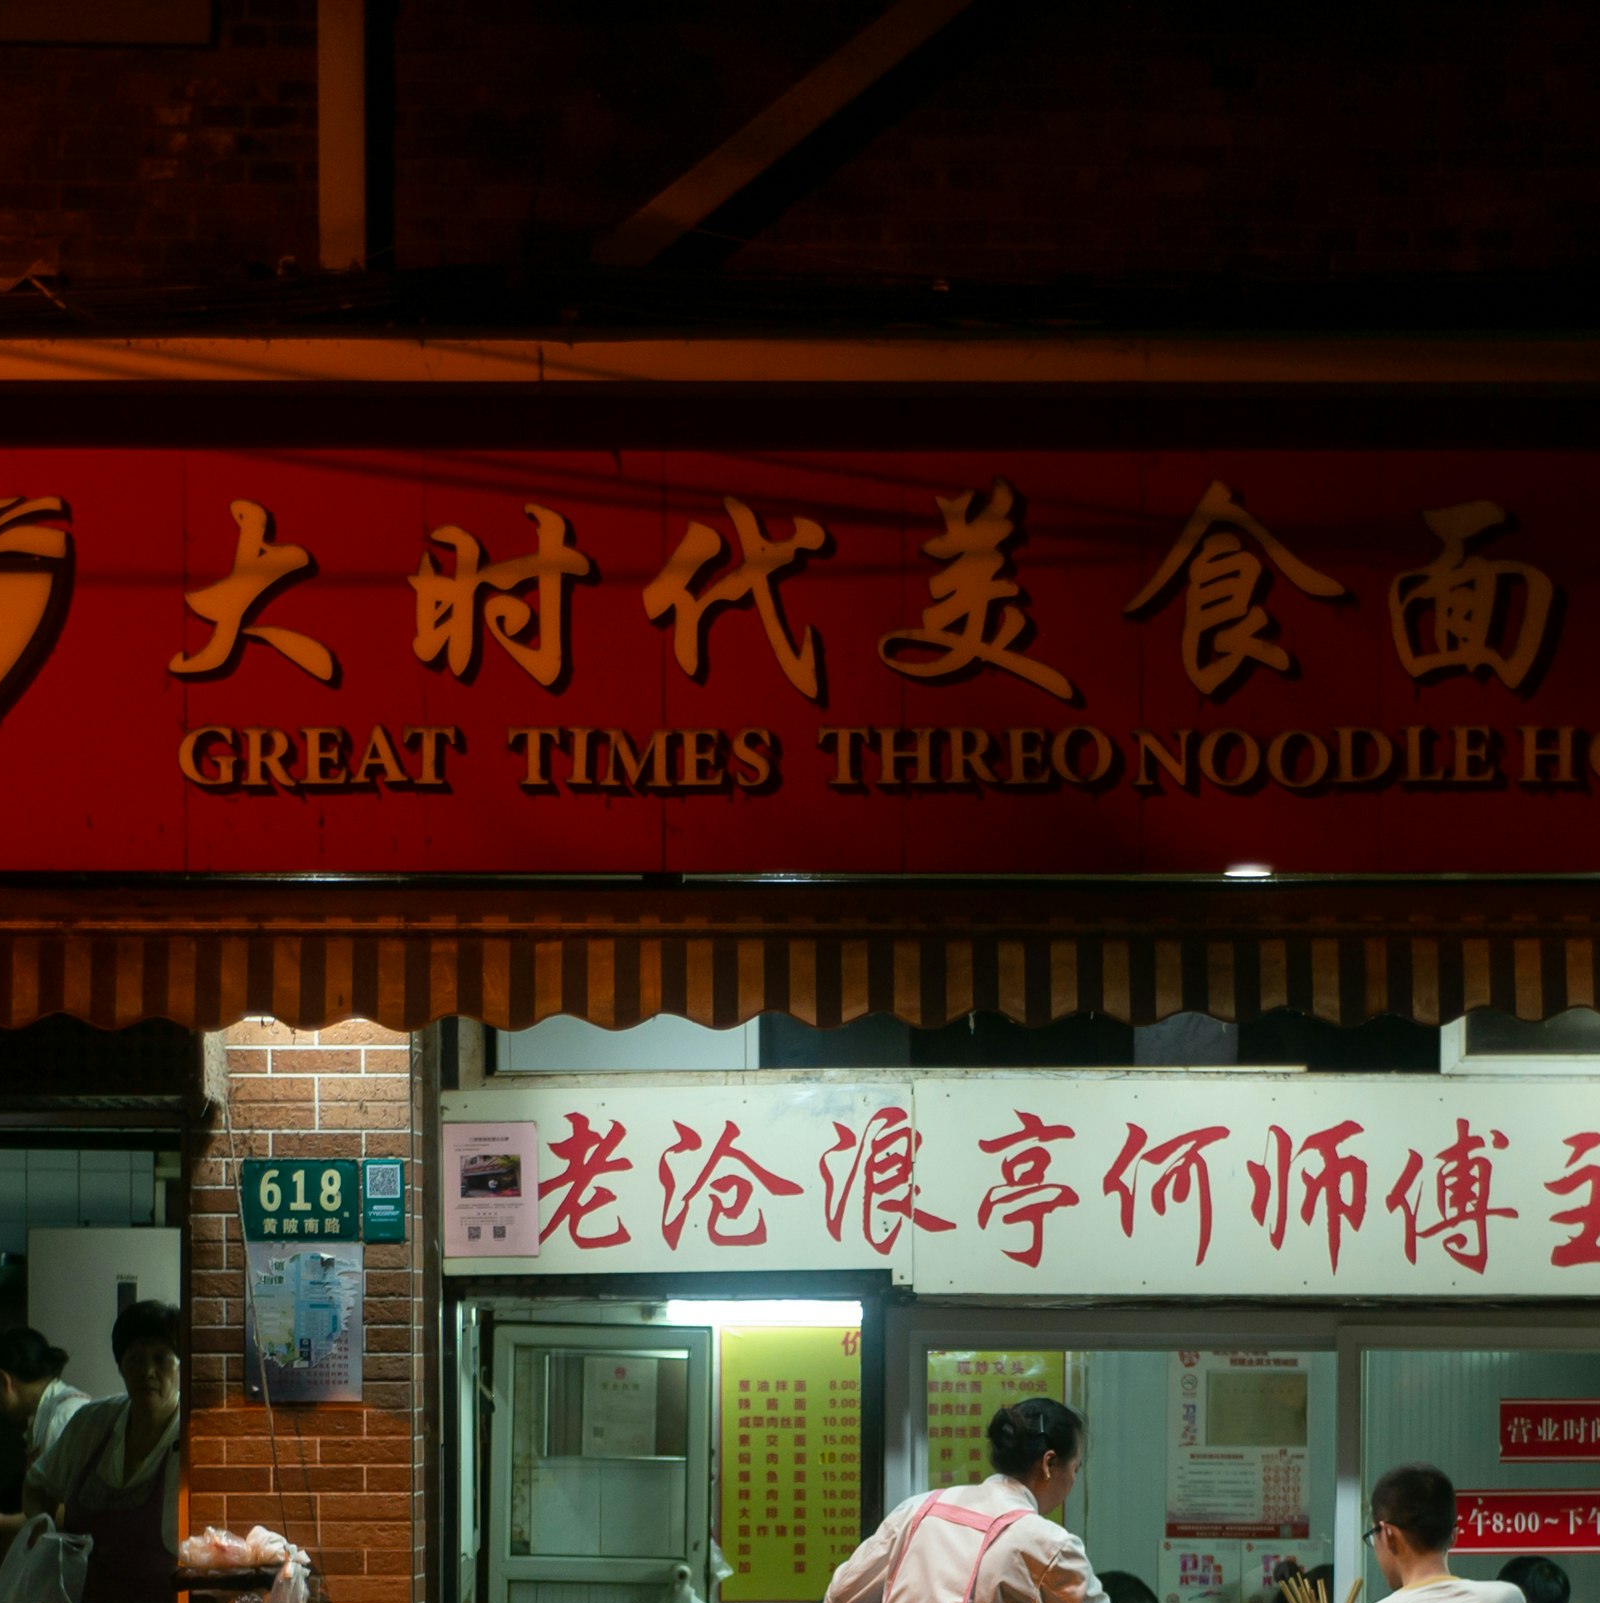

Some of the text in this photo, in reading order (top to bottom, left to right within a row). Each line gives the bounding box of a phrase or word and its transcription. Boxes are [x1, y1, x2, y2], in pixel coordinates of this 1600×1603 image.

[177, 724, 456, 788] GREAT
[508, 725, 774, 790] TIMES
[818, 725, 1114, 788] THREO
[1132, 725, 1495, 790] NOODLE
[258, 1169, 343, 1213] 618
[263, 1217, 341, 1236] 黄陂南路
